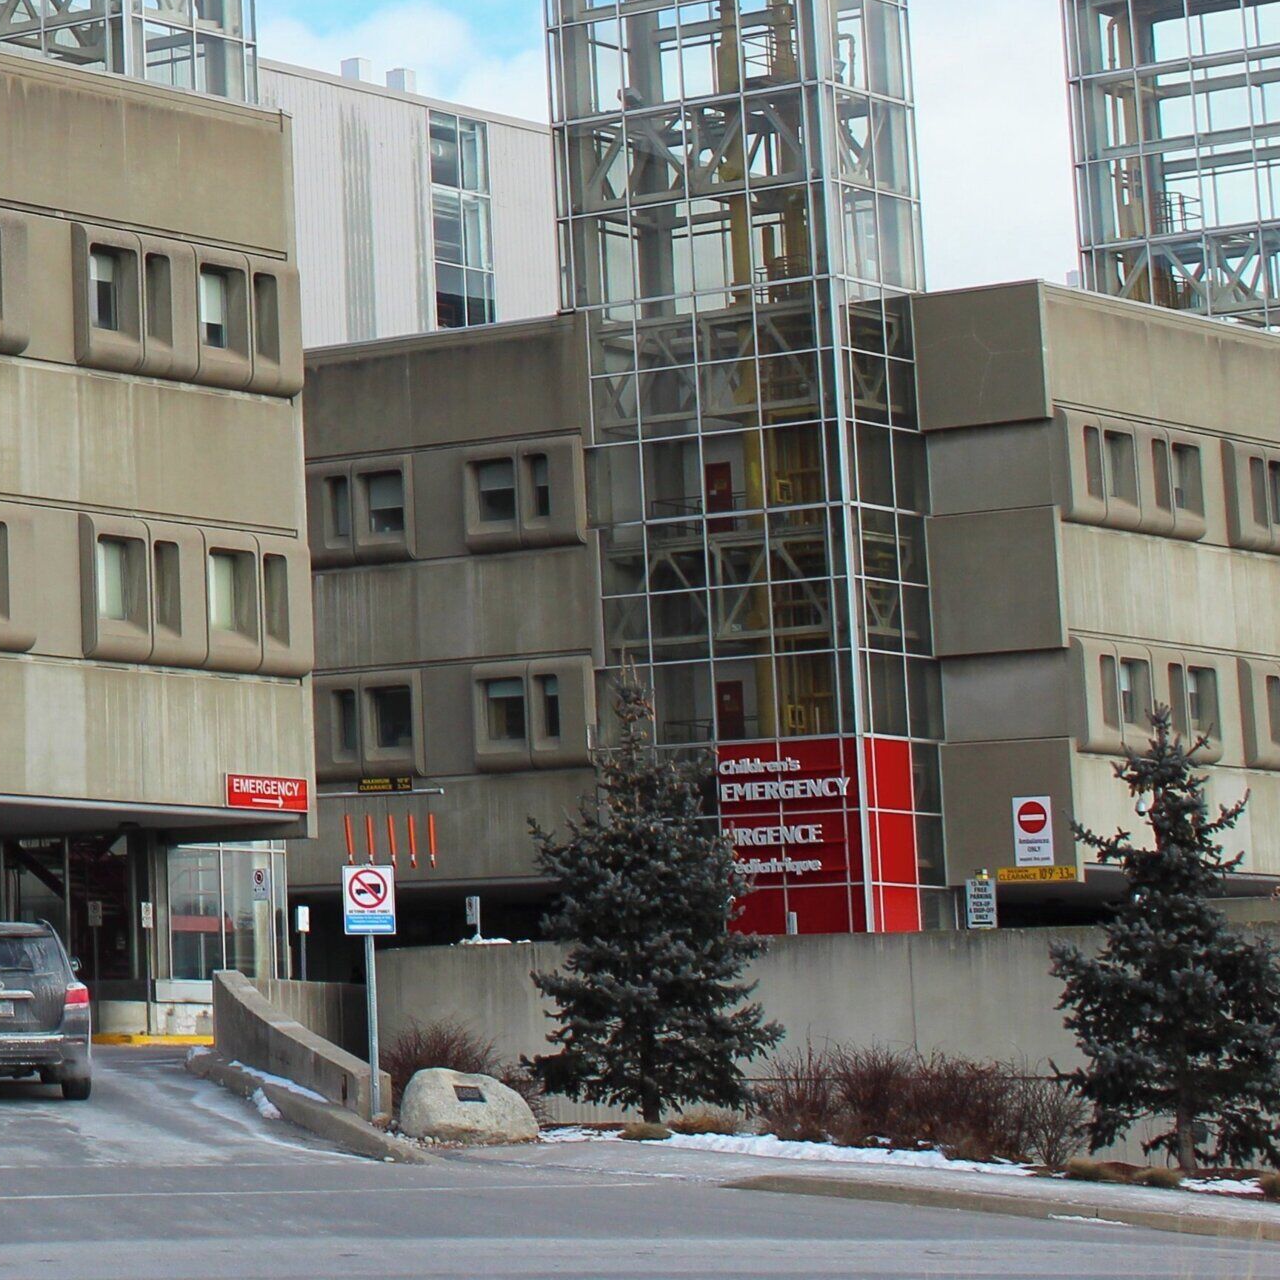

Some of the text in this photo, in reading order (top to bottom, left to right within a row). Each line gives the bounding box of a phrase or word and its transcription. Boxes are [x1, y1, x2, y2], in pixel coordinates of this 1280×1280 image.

[719, 756, 801, 775] Children's
[233, 778, 300, 797] EMERGENCY
[720, 776, 851, 802] EMERGENCY
[732, 856, 823, 876] édiatrique
